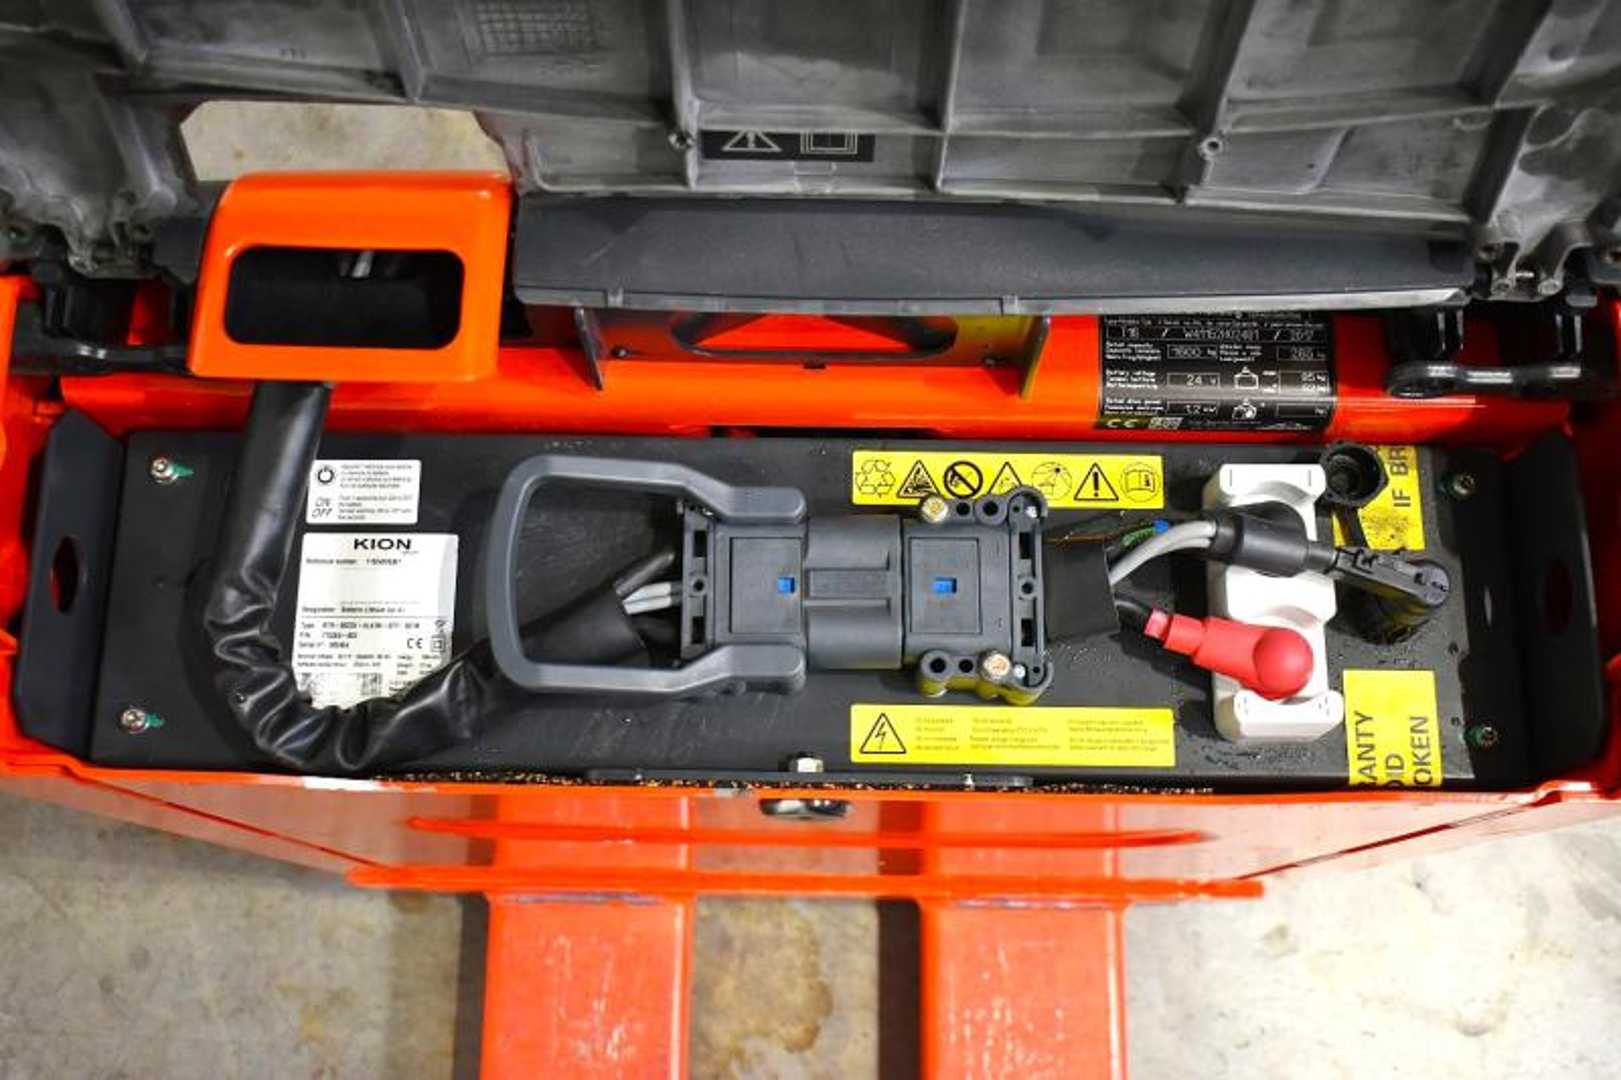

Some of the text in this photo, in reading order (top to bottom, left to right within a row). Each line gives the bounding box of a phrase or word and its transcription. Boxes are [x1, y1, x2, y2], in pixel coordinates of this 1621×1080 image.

[1186, 374, 1202, 387] 24
[315, 497, 331, 507] ON
[1391, 488, 1411, 507] IF
[311, 507, 333, 517] OFF
[353, 538, 412, 550] KION
[1353, 711, 1378, 785] ANTY
[1410, 716, 1434, 785] OKEN
